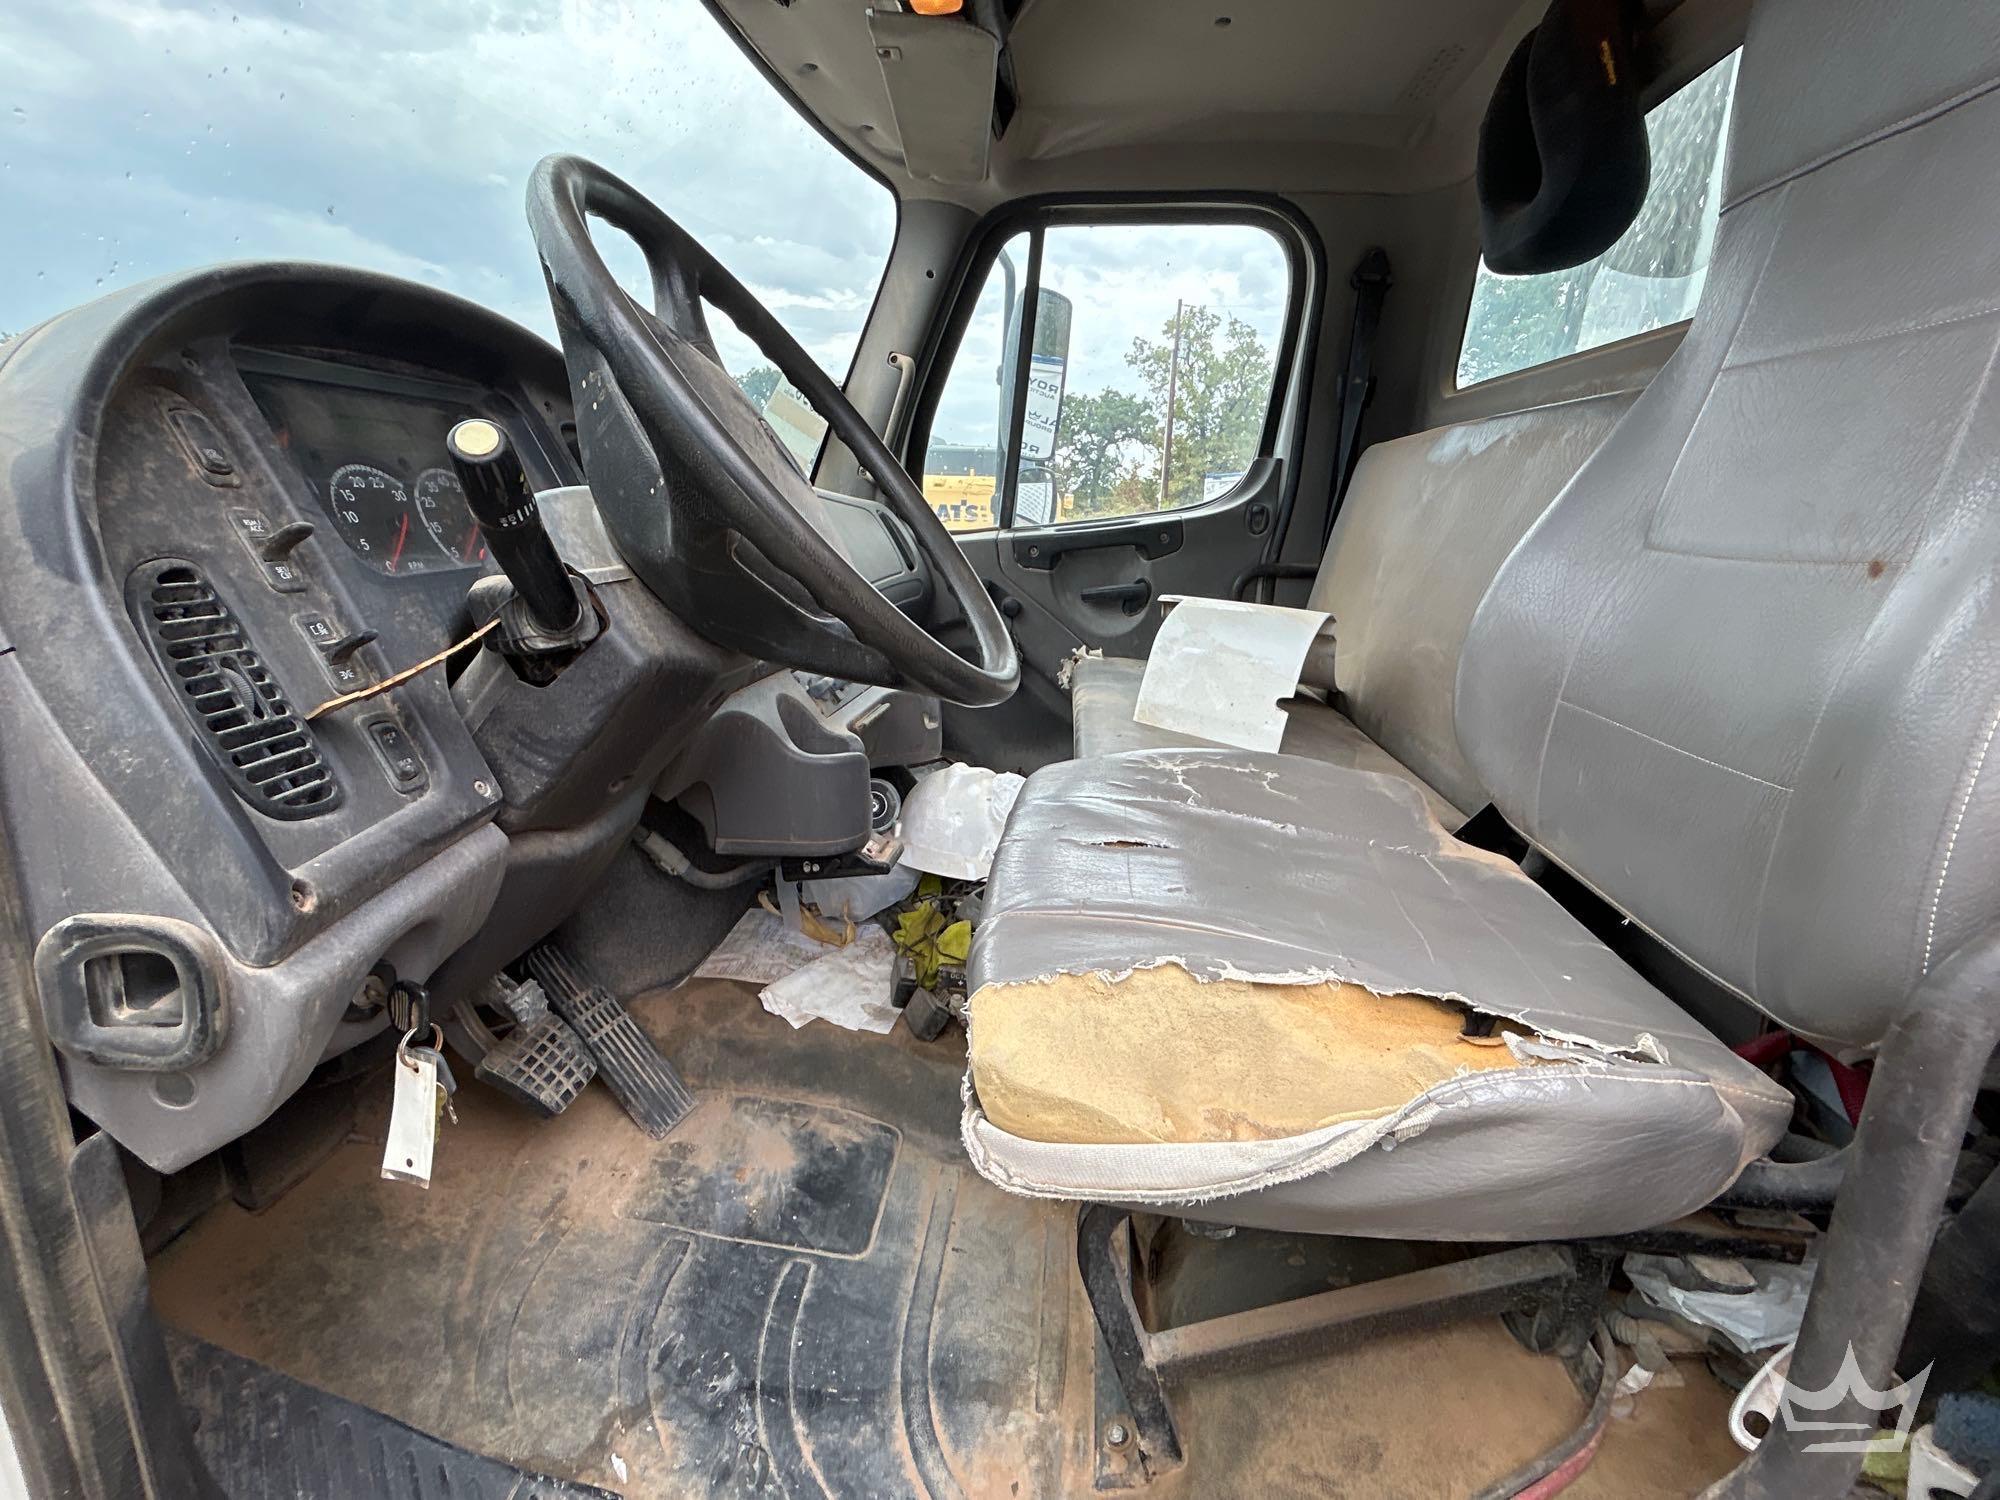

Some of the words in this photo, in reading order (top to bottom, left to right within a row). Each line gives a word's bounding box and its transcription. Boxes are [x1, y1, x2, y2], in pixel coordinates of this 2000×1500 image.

[348, 476, 366, 488] 20
[368, 476, 385, 489] 25
[340, 489, 356, 502] 15
[391, 490, 407, 502] 30
[421, 496, 436, 508] 25
[342, 510, 360, 524] 10
[430, 521, 443, 534] 15
[360, 538, 370, 551] 5
[450, 546, 460, 559] 5
[407, 561, 424, 569] RPM
